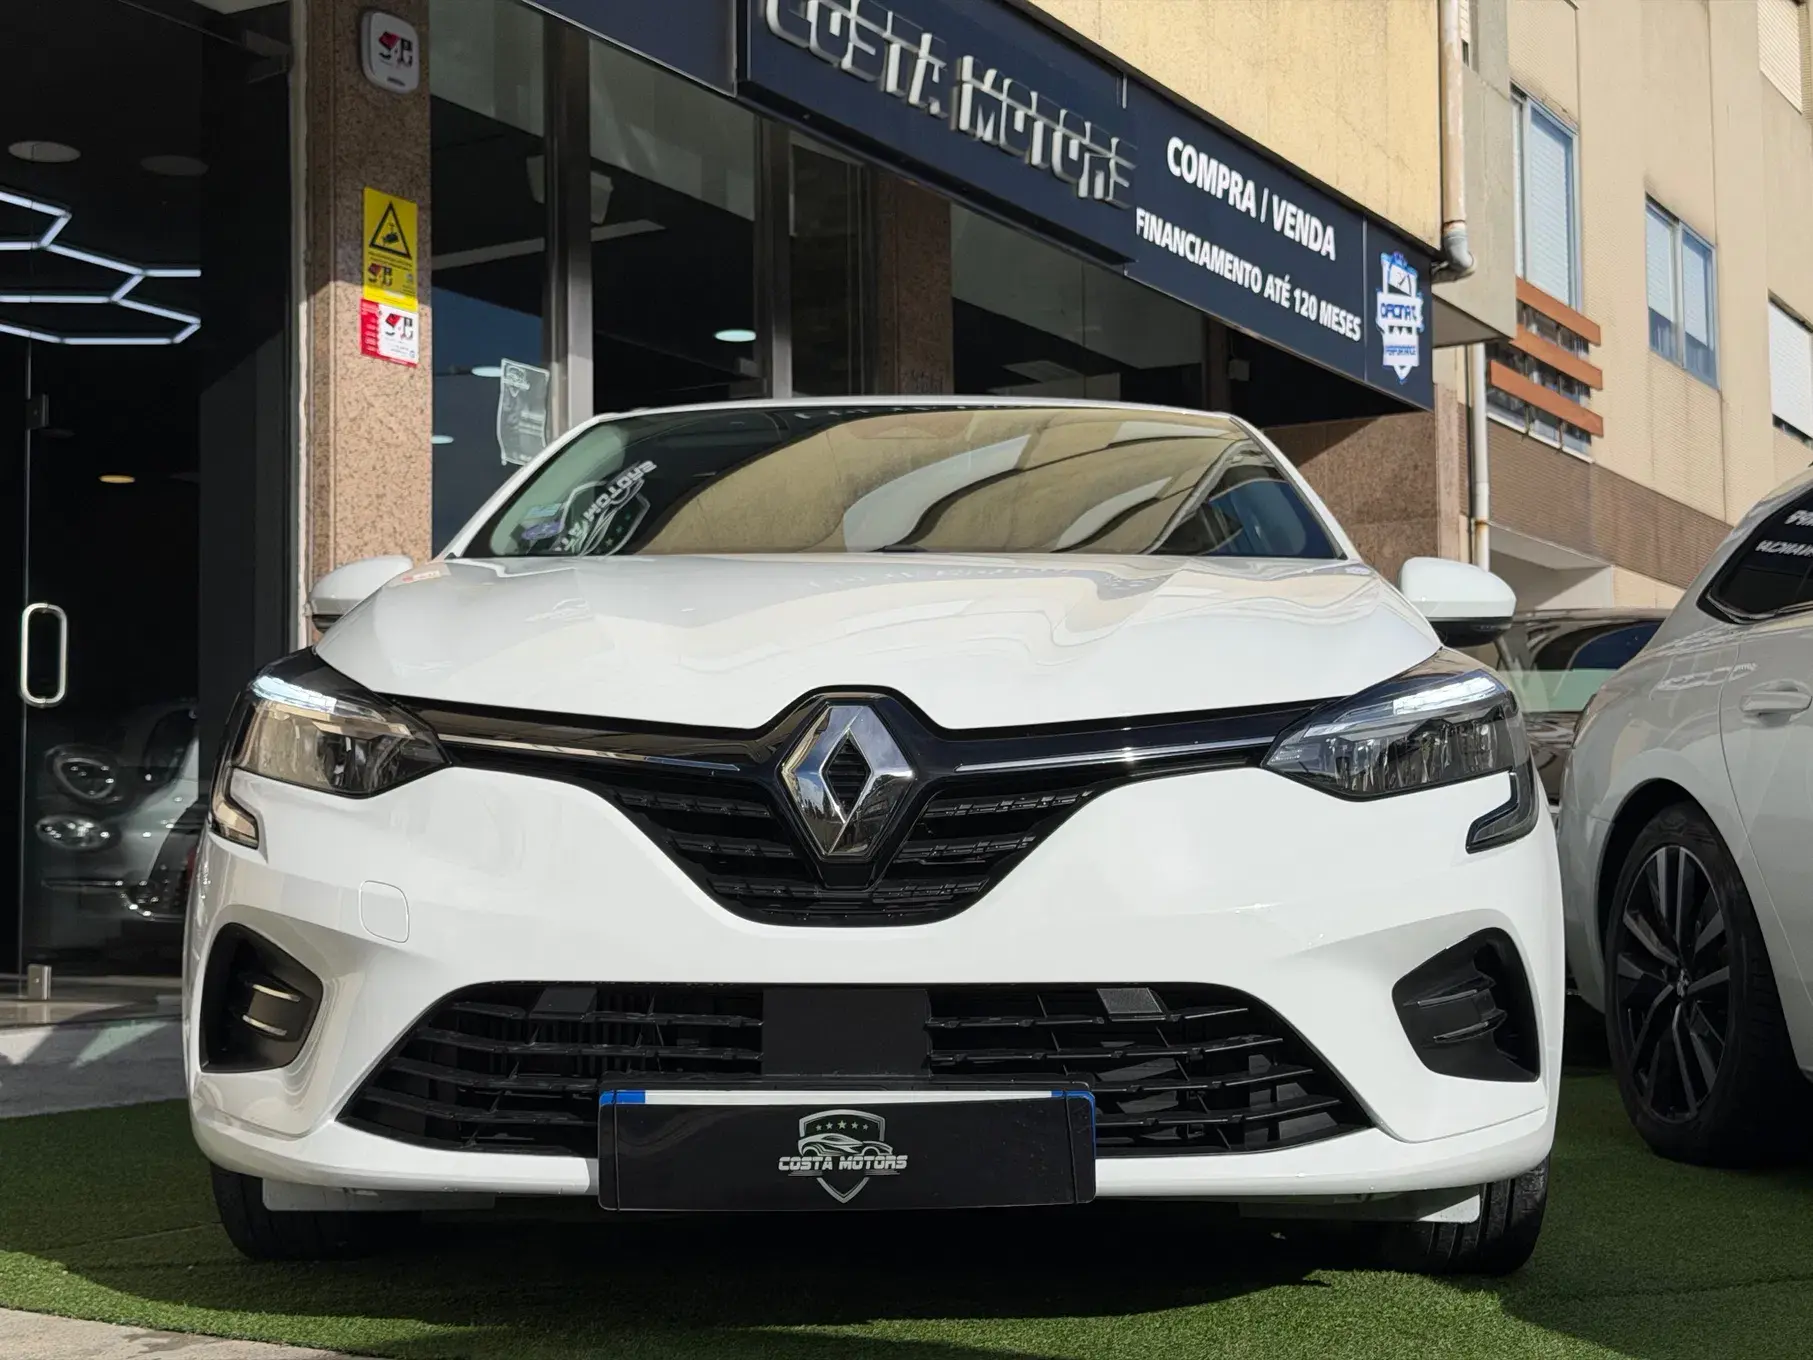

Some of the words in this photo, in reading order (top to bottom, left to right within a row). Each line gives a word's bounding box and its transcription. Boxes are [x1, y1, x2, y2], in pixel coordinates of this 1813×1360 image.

[1167, 136, 1257, 218] COMPRA
[1272, 194, 1336, 261] VENDA
[1136, 207, 1262, 293] FINANCIAMENTO
[1263, 274, 1291, 308] ATÉ
[1293, 287, 1318, 321] 120
[1319, 301, 1361, 341] MESES
[778, 1156, 833, 1171] COSTA
[839, 1155, 908, 1170] MOTORS
